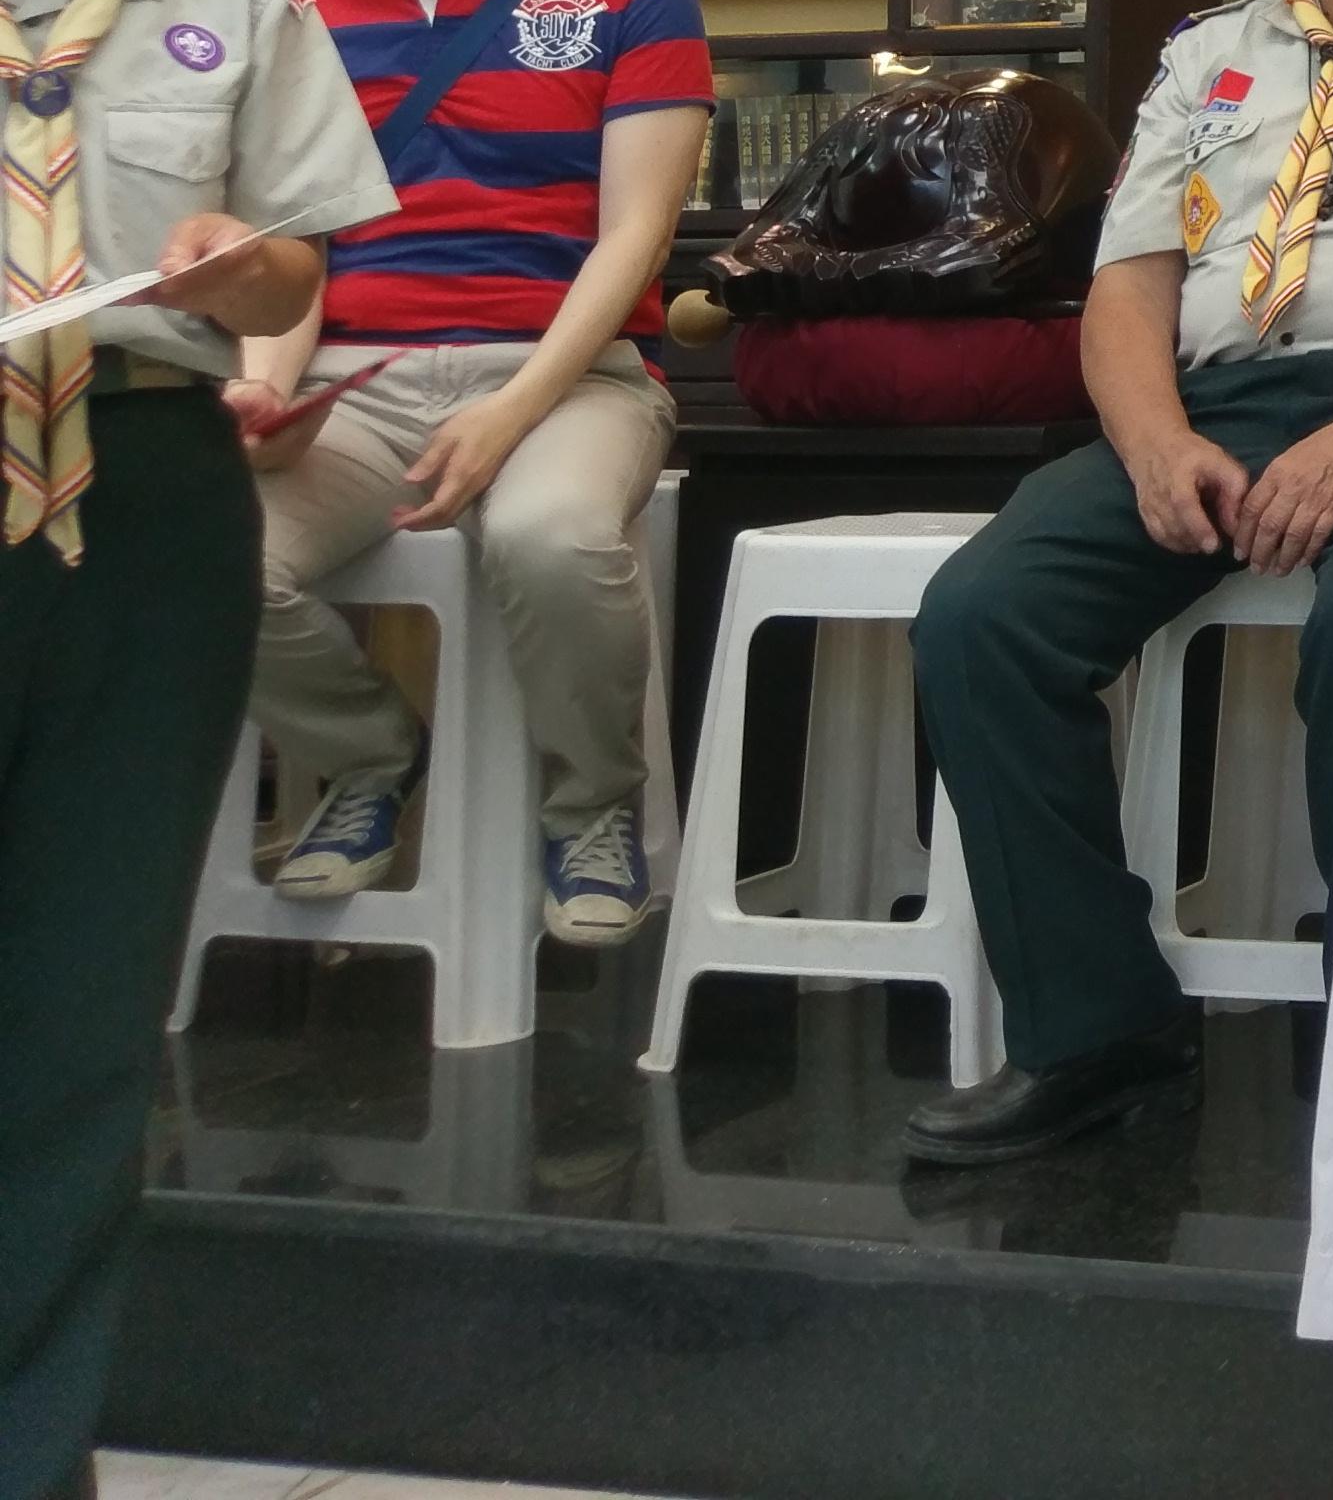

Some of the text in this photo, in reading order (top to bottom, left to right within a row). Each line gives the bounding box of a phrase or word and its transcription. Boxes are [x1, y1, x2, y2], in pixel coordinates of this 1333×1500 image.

[540, 11, 574, 39] SDYC
[525, 53, 585, 69] YACHT CLUB
